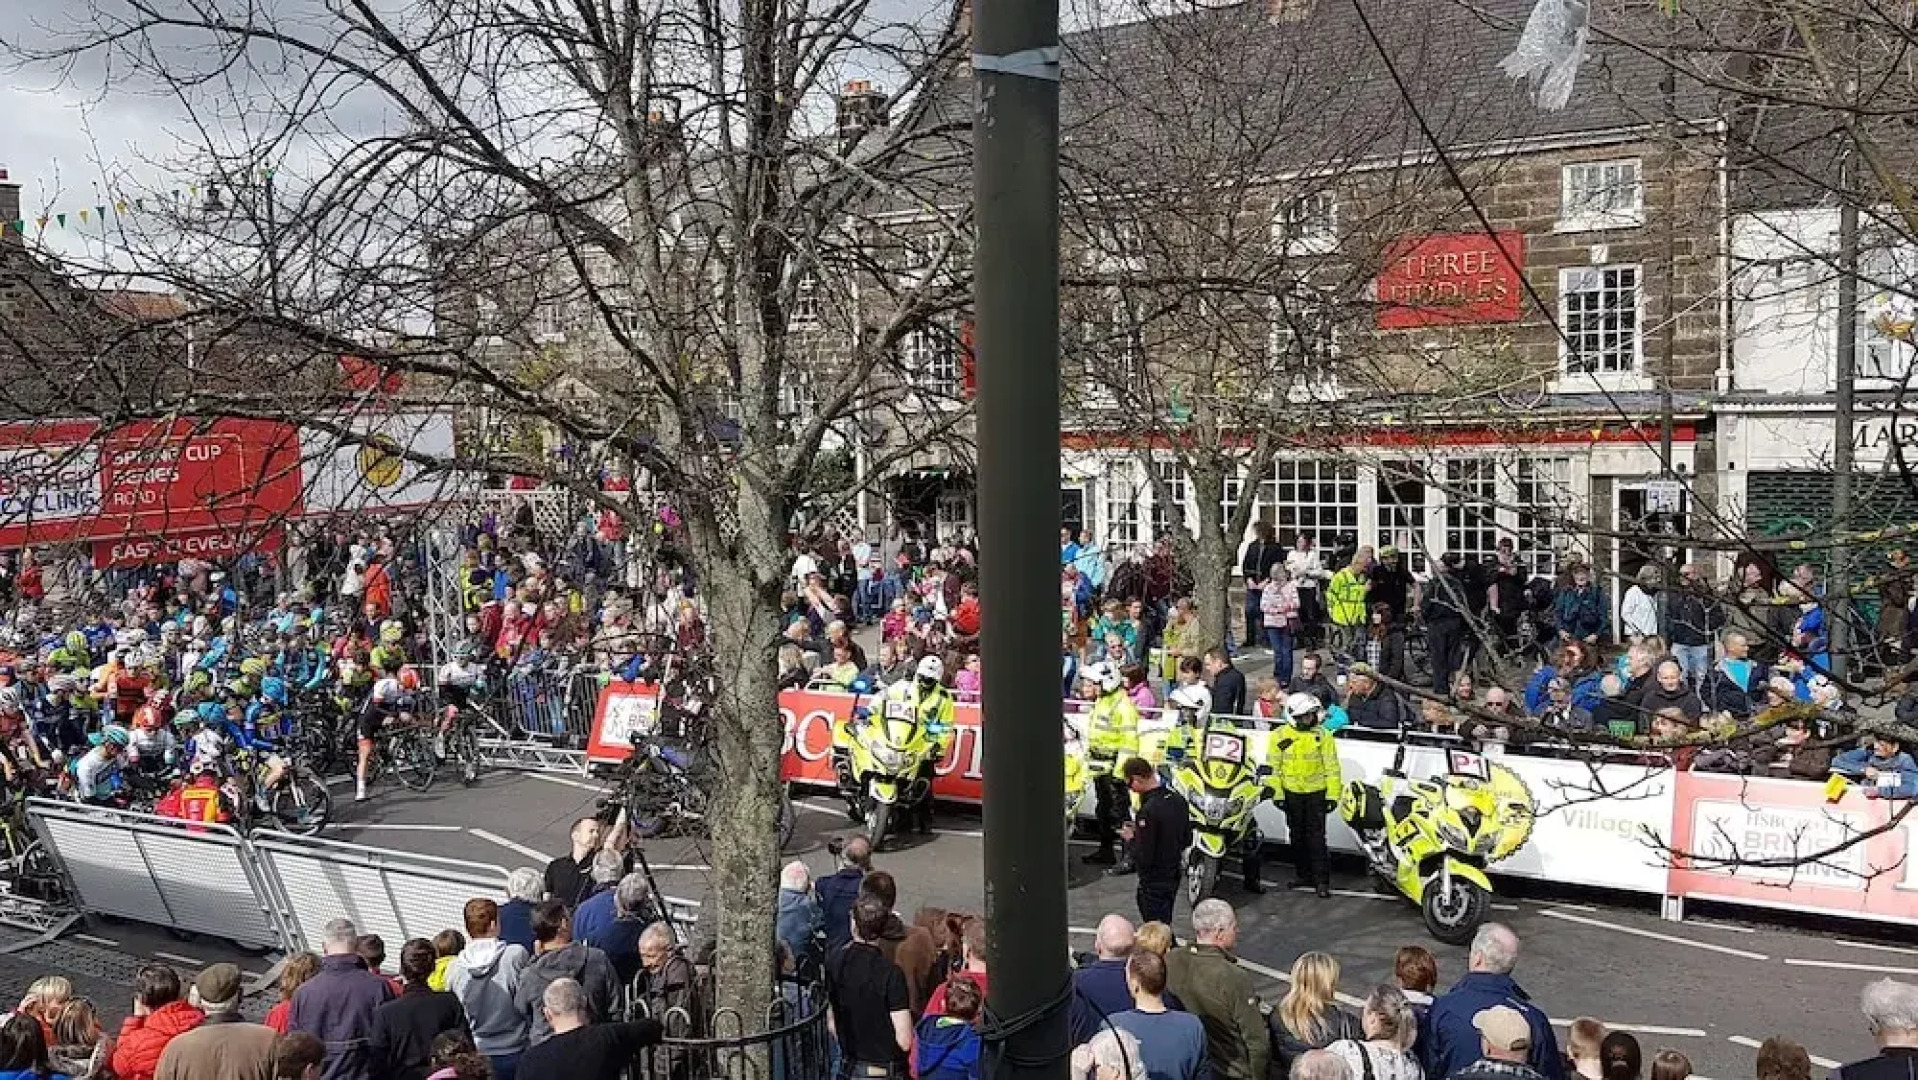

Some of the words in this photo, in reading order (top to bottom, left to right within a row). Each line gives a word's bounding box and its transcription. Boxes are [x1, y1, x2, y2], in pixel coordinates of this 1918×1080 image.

[1400, 249, 1497, 279] THREE
[186, 444, 222, 461] CUP
[114, 490, 156, 506] ROAD
[1209, 737, 1240, 758] P2
[1454, 755, 1484, 772] P1
